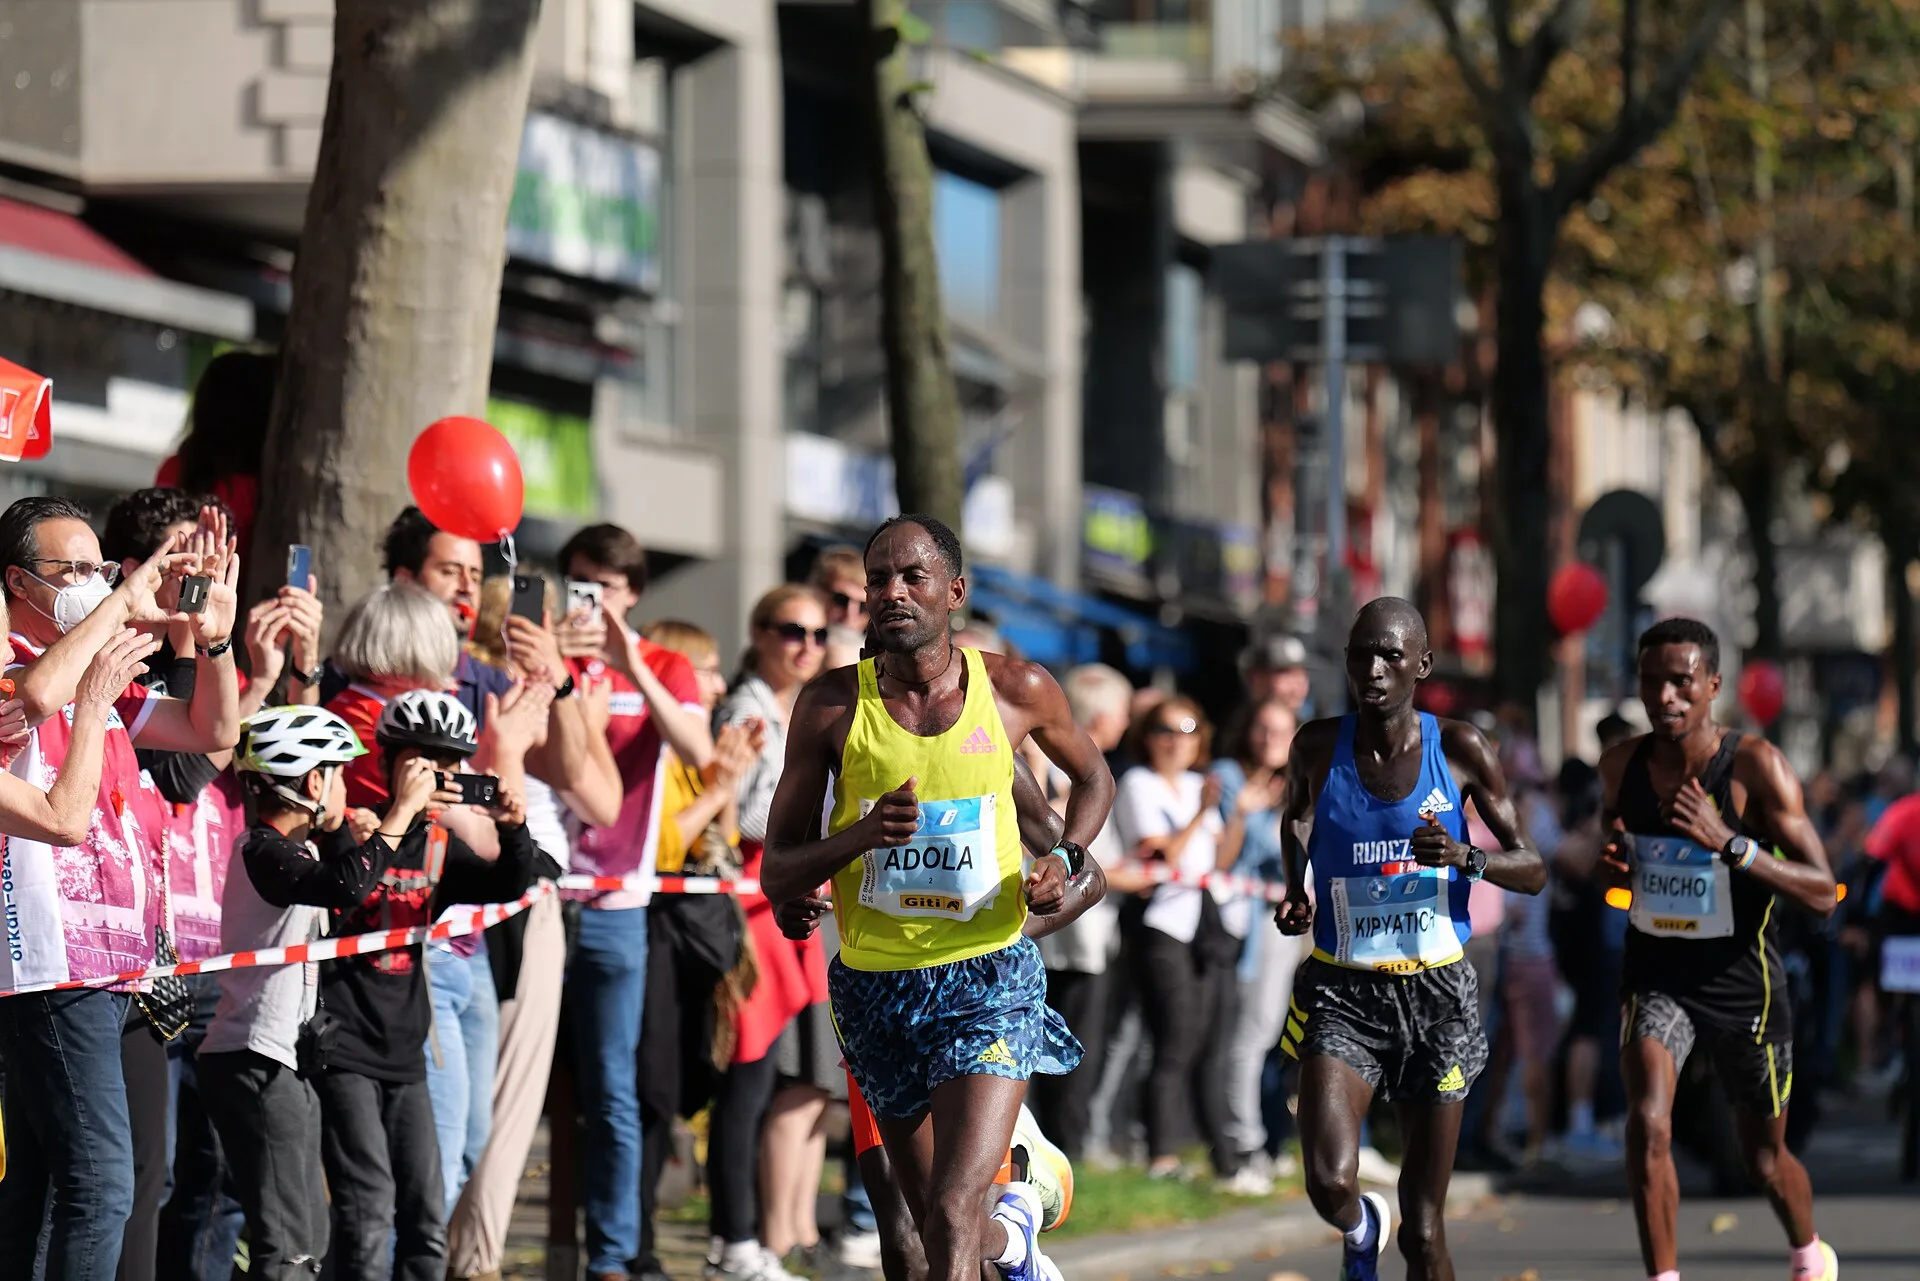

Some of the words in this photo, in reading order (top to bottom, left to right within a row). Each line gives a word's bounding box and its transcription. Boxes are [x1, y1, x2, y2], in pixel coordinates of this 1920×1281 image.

[960, 744, 997, 754] adidas
[883, 846, 973, 871] ADOLA
[1353, 839, 1415, 865] RUNCZ
[1642, 872, 1707, 898] LENCHO
[904, 897, 941, 908] Giti
[1355, 906, 1436, 939] KIPYATICH
[1377, 963, 1409, 972] Giti
[977, 1053, 1017, 1068] adidas
